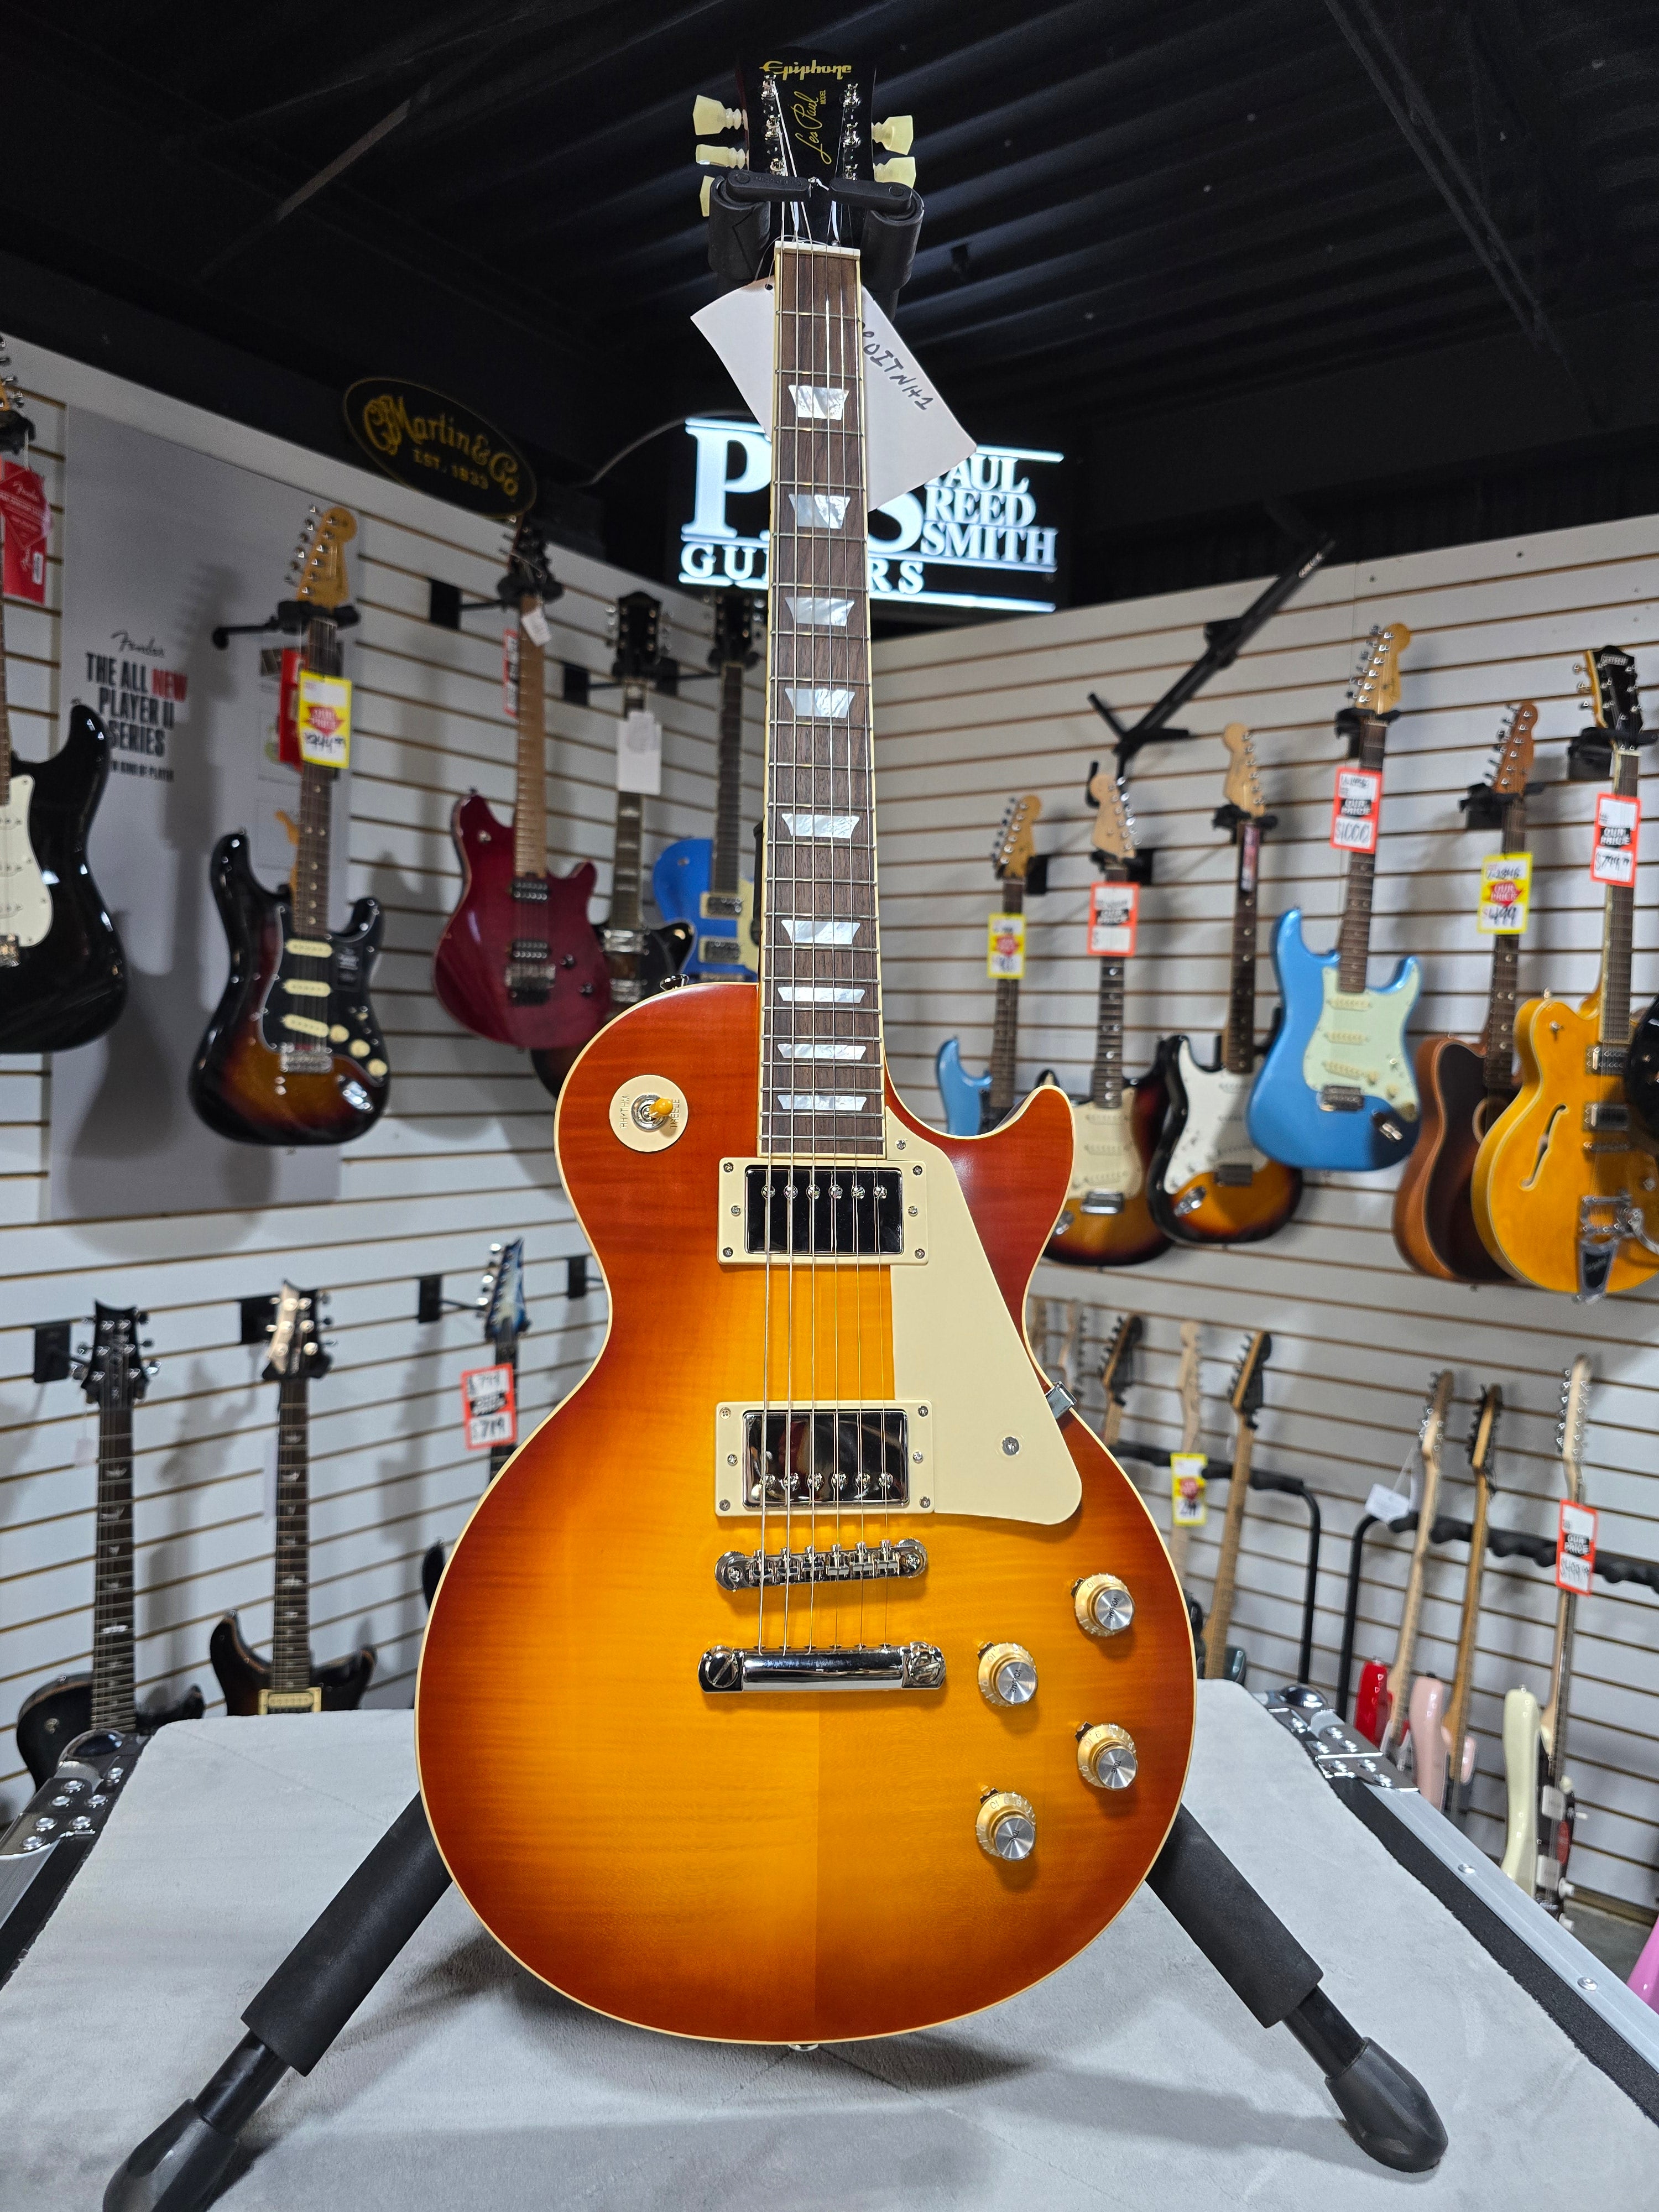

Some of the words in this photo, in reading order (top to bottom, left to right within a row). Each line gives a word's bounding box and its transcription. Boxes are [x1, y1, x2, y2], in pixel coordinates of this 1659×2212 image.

[759, 59, 852, 81] Epiphone
[790, 91, 823, 129] Paul
[795, 132, 832, 165] Les
[925, 487, 1037, 529] REED
[920, 523, 1059, 565] SMITH
[86, 651, 117, 686] THE
[121, 660, 148, 693] ALL
[151, 666, 187, 703] NEW
[98, 686, 159, 726] PLAYER
[108, 719, 165, 757] SERIES
[1600, 836, 1631, 846] PRICE
[1603, 827, 1626, 838] OUR
[1490, 892, 1519, 902] PRICE
[1494, 883, 1515, 894] OUR
[619, 1095, 630, 1129] RHYTHM
[1564, 1541, 1590, 1555] PRICE
[1567, 1534, 1587, 1545] OUR
[1107, 1597, 1120, 1621] VOLUME
[1111, 1760, 1121, 1774] TONE
